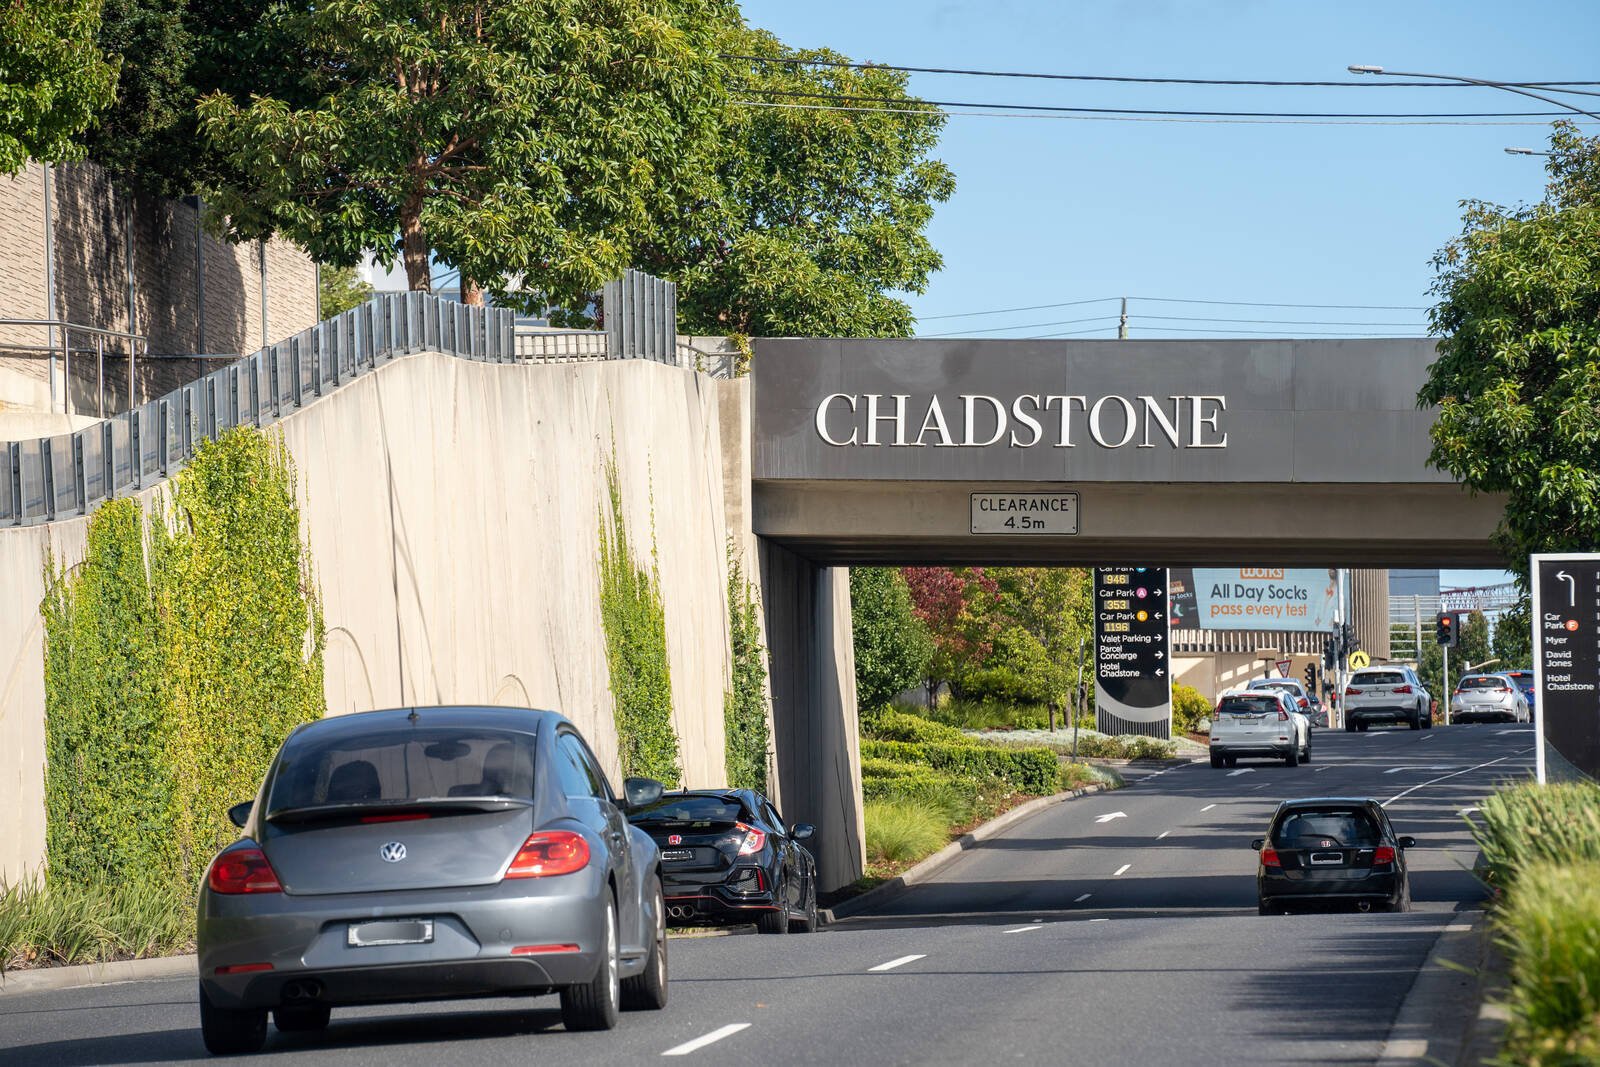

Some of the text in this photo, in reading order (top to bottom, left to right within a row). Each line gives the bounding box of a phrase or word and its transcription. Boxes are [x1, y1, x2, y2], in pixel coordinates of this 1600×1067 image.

[814, 392, 1228, 449] CHADSTONE
[979, 498, 1069, 512] CLEARANCE
[1003, 516, 1046, 530] 4.5m
[1106, 574, 1126, 584] 946
[1099, 589, 1114, 597] Car
[1116, 589, 1135, 597] Park
[1210, 584, 1308, 602] All Day Socks
[1107, 600, 1126, 609] 353
[1210, 603, 1307, 618] pass every test
[1099, 612, 1114, 620] Car
[1116, 612, 1136, 620] Park
[1544, 613, 1560, 621] Car
[1544, 621, 1565, 630] Park
[1100, 634, 1151, 643] Valet Parking
[1545, 637, 1568, 646] Myer
[1100, 645, 1123, 653] Parcel
[1100, 652, 1138, 661] Concierge
[1545, 651, 1572, 659] David
[1100, 662, 1121, 670] Hotel
[1545, 659, 1573, 668] Jones
[1100, 669, 1140, 678] Chadstone
[1546, 674, 1571, 682] Hotel
[1547, 682, 1595, 691] Chadstone
